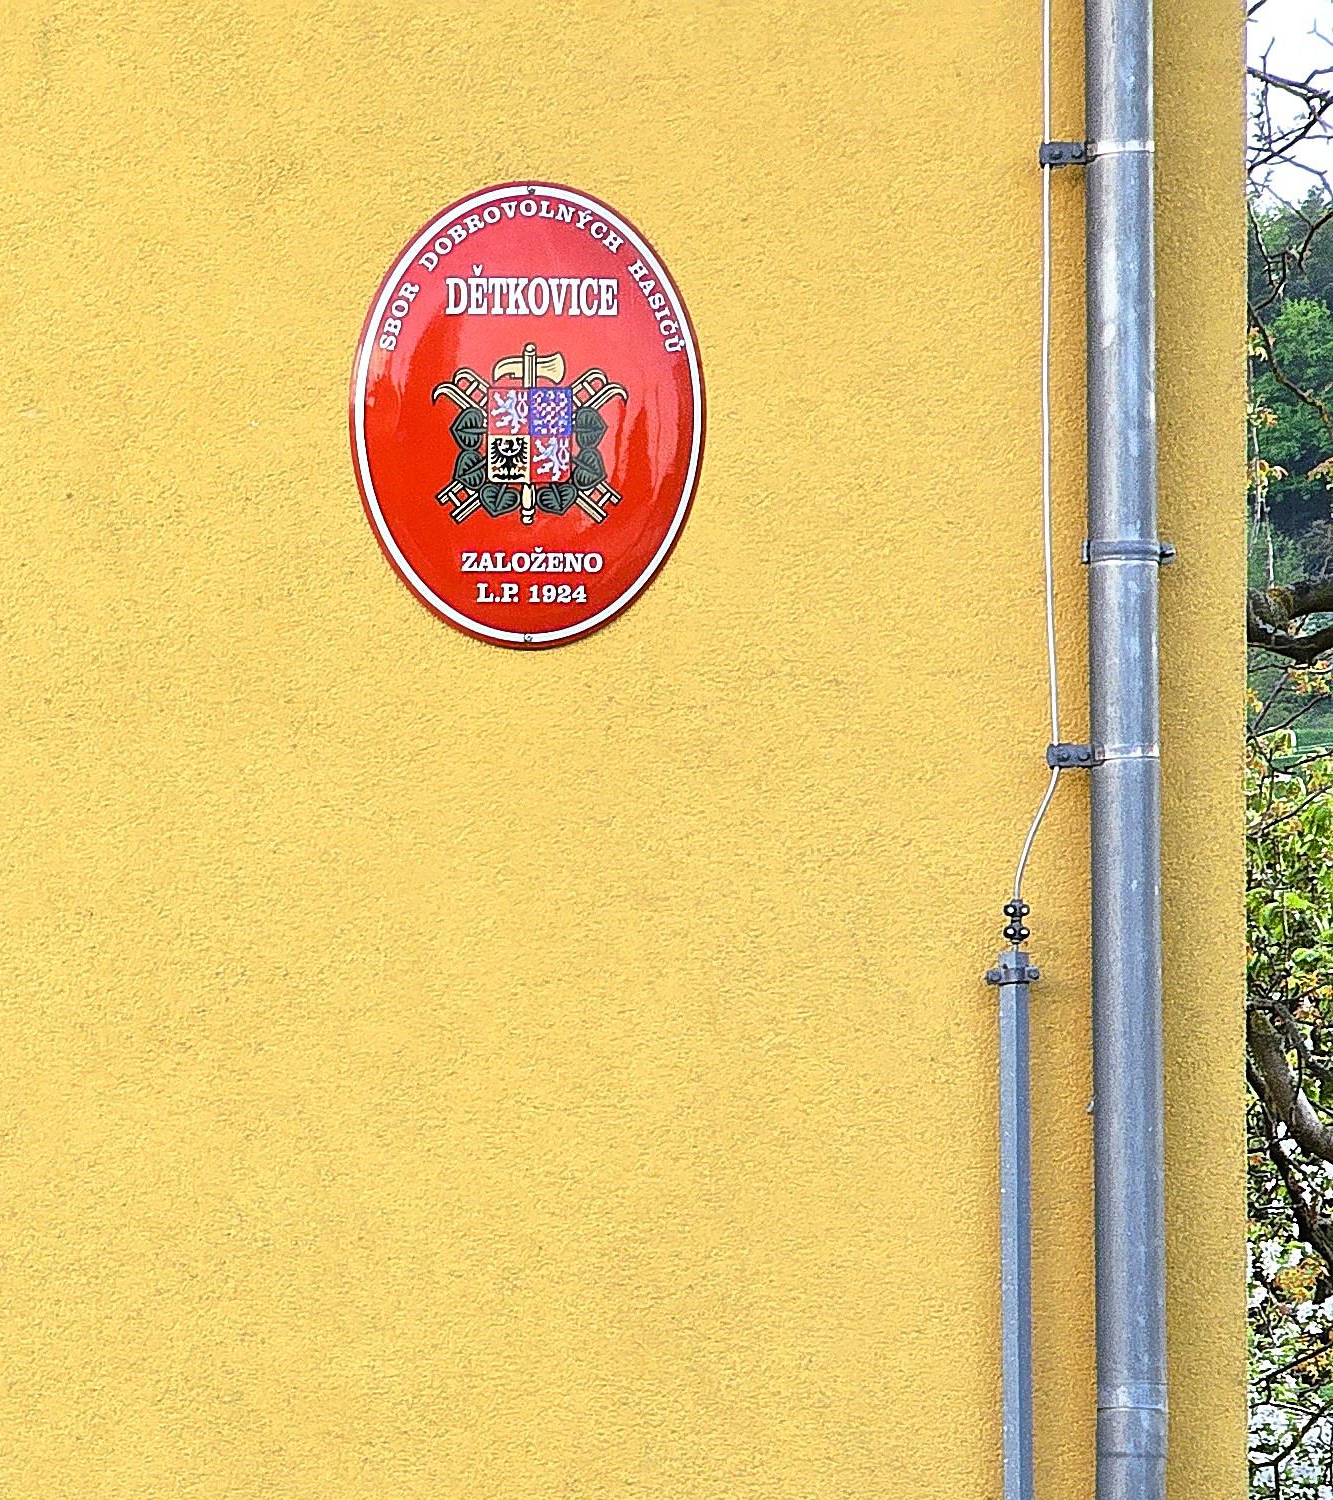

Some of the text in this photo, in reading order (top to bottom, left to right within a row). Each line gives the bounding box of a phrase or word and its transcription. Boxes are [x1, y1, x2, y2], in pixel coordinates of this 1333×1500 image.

[379, 199, 683, 353] SBOR DOBROVOLNÝCH HASIČŮ
[445, 264, 618, 316] DĚTKOVICE
[461, 546, 603, 573] ZALOŽENO
[476, 584, 587, 603] L.P. 1924
